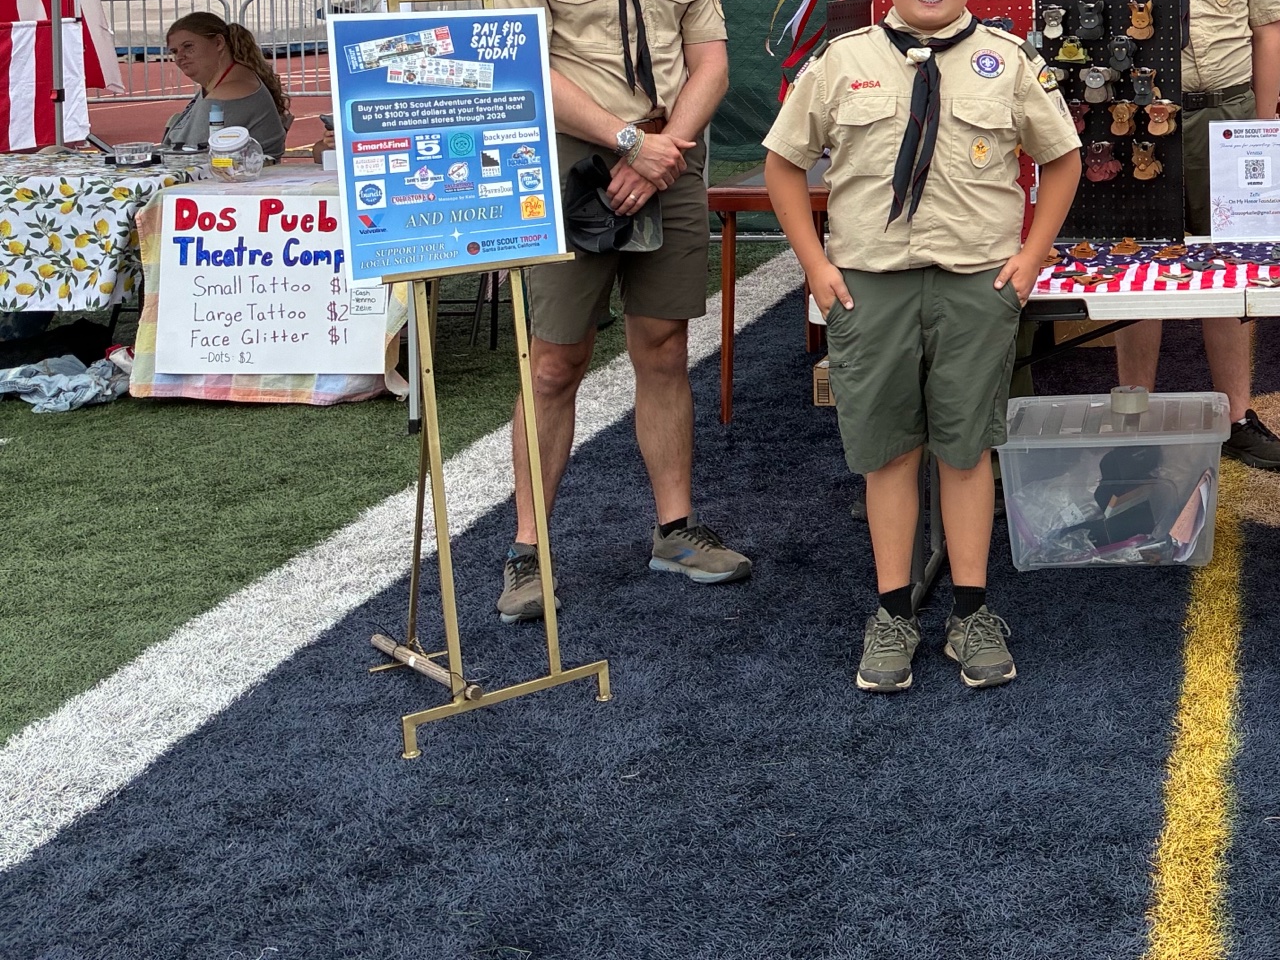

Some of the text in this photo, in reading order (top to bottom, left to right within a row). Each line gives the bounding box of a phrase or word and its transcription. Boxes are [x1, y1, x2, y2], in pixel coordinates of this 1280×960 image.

[472, 20, 523, 38] PAY $10
[470, 33, 527, 49] SAVE $10
[477, 46, 518, 61] TODAY
[862, 80, 881, 89] BSA
[357, 104, 373, 113] Buy
[374, 103, 392, 112] your
[394, 101, 408, 110] $10
[410, 100, 432, 109] Scout
[433, 98, 472, 108] Adventure
[474, 97, 494, 105] Card
[493, 95, 507, 103] and
[362, 102, 523, 121] up to $100's of dollars at your favorite local
[381, 112, 507, 127] and national stores through 2026
[483, 130, 540, 142] backyard bowls
[356, 139, 409, 151] Smart&Final
[416, 140, 441, 156] 5
[391, 193, 427, 203] COLD STONE
[174, 197, 338, 233] Dos Pueb
[405, 205, 504, 228] AND MORE!
[358, 227, 388, 235] Valvoline
[481, 233, 548, 248] BOY SCOUT TROOP 4
[481, 246, 496, 254] Santa
[517, 241, 541, 249] California
[172, 236, 345, 274] Theatre Comp
[375, 242, 446, 258] SUPPORT YOUR
[360, 250, 459, 270] LOCAL SCOUT TROOP
[192, 274, 348, 297] Small Tattoo $1
[193, 300, 349, 328] Large Tattoo $2
[190, 325, 348, 348] Face Glitter $1
[238, 351, 255, 365] $2
